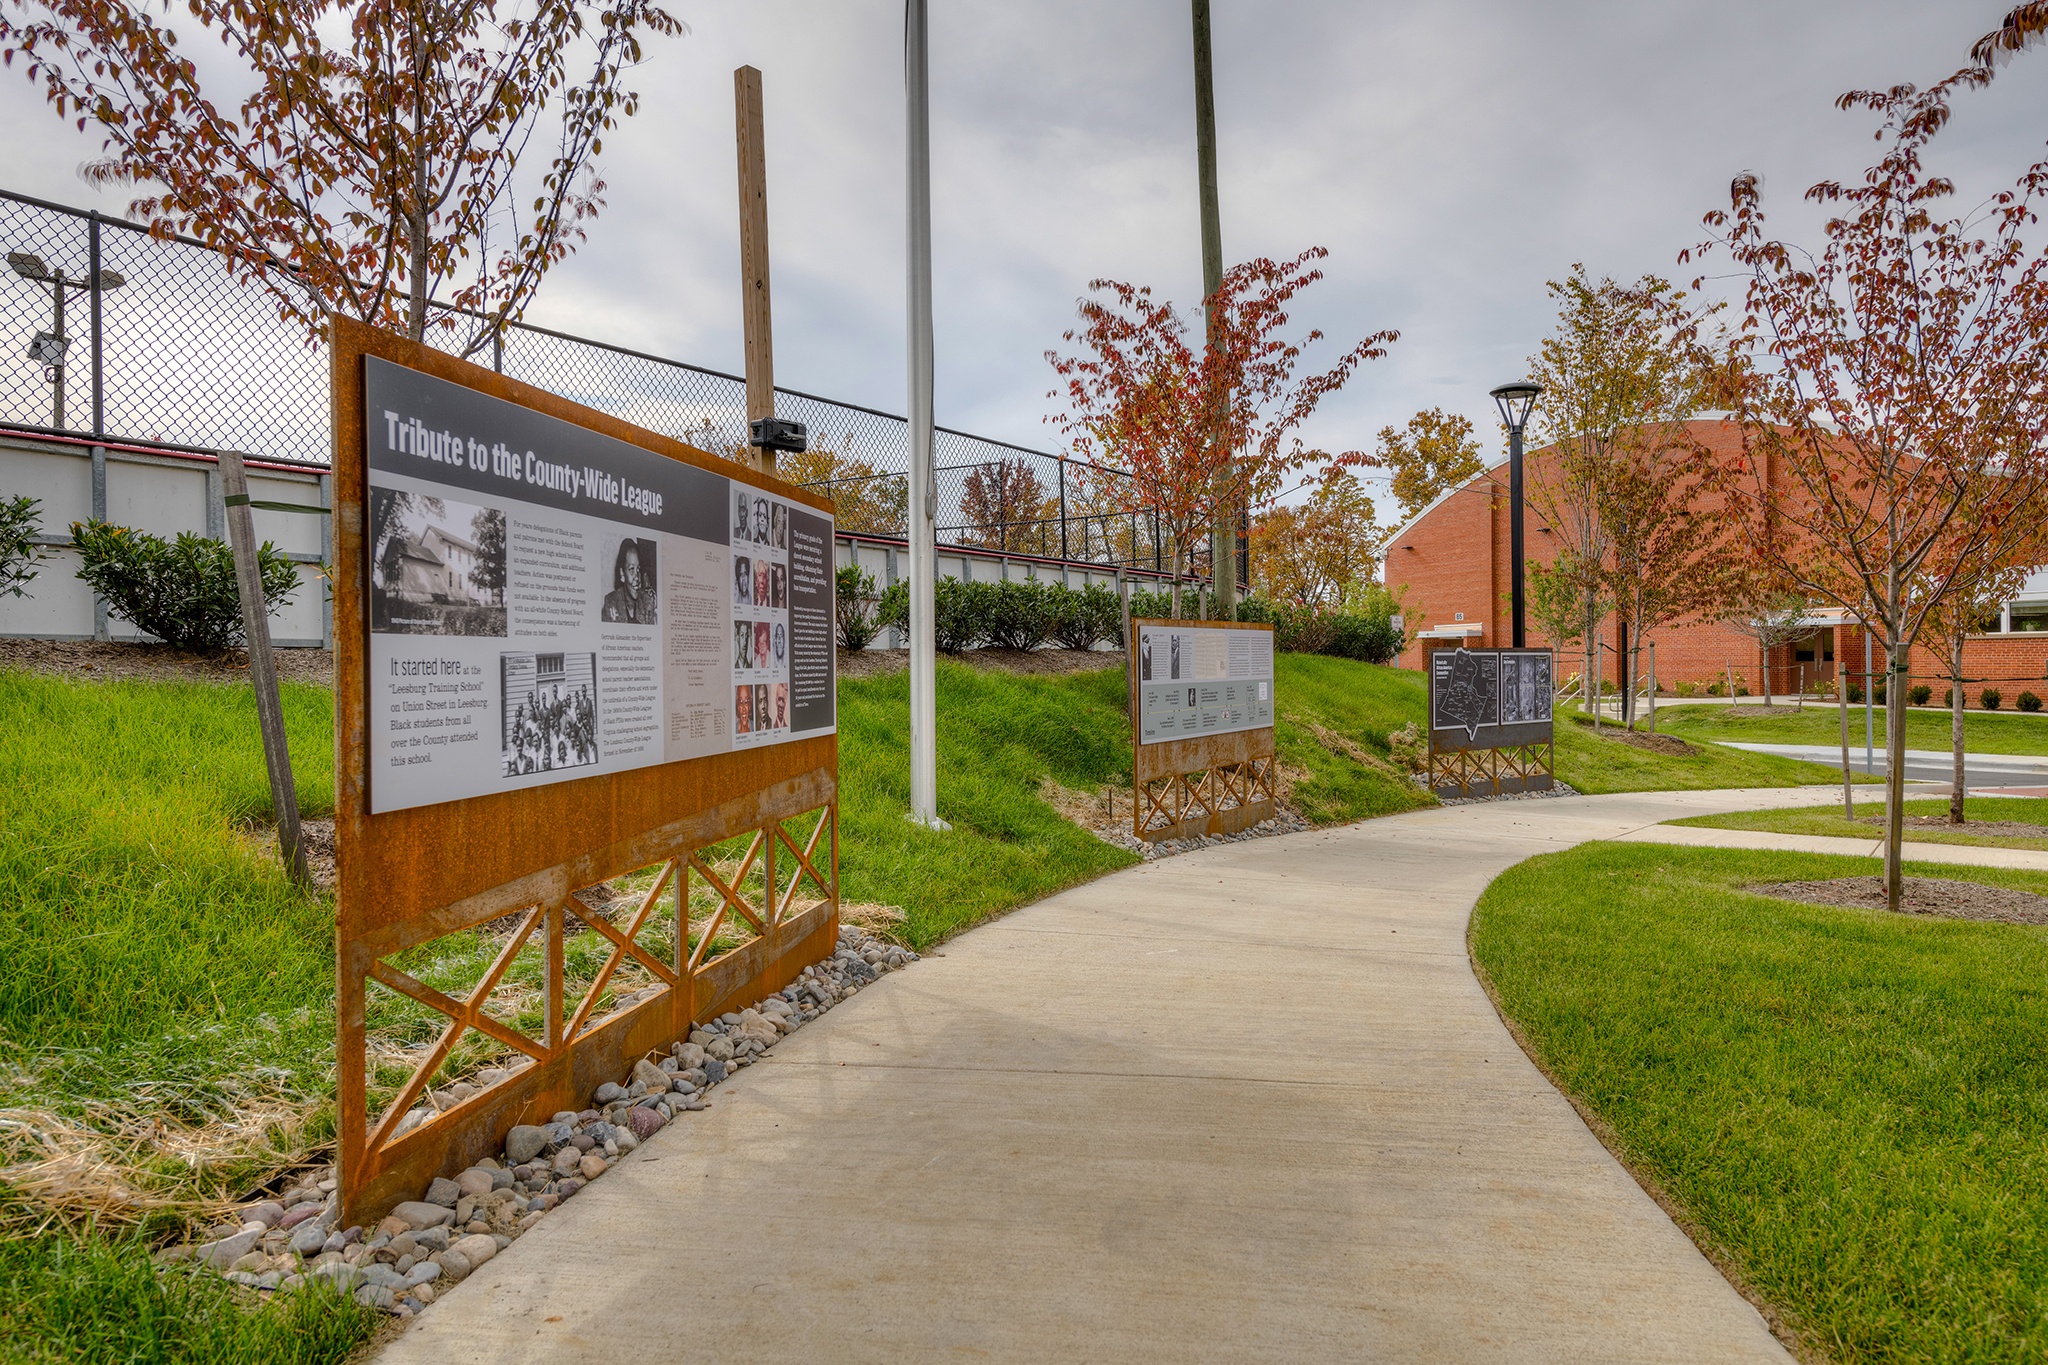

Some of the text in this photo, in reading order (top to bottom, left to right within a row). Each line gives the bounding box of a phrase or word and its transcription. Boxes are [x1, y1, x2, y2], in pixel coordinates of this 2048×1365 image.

[384, 410, 663, 516] Tribute to the County-Wide League
[391, 658, 481, 676] It started here at the
[428, 683, 459, 694] Training
[390, 704, 400, 712] on
[403, 701, 424, 712] Union
[426, 700, 447, 710] Street
[449, 700, 456, 709] in
[390, 715, 471, 730] Black students from all
[391, 731, 478, 748] over the County attended
[391, 757, 406, 766] this
